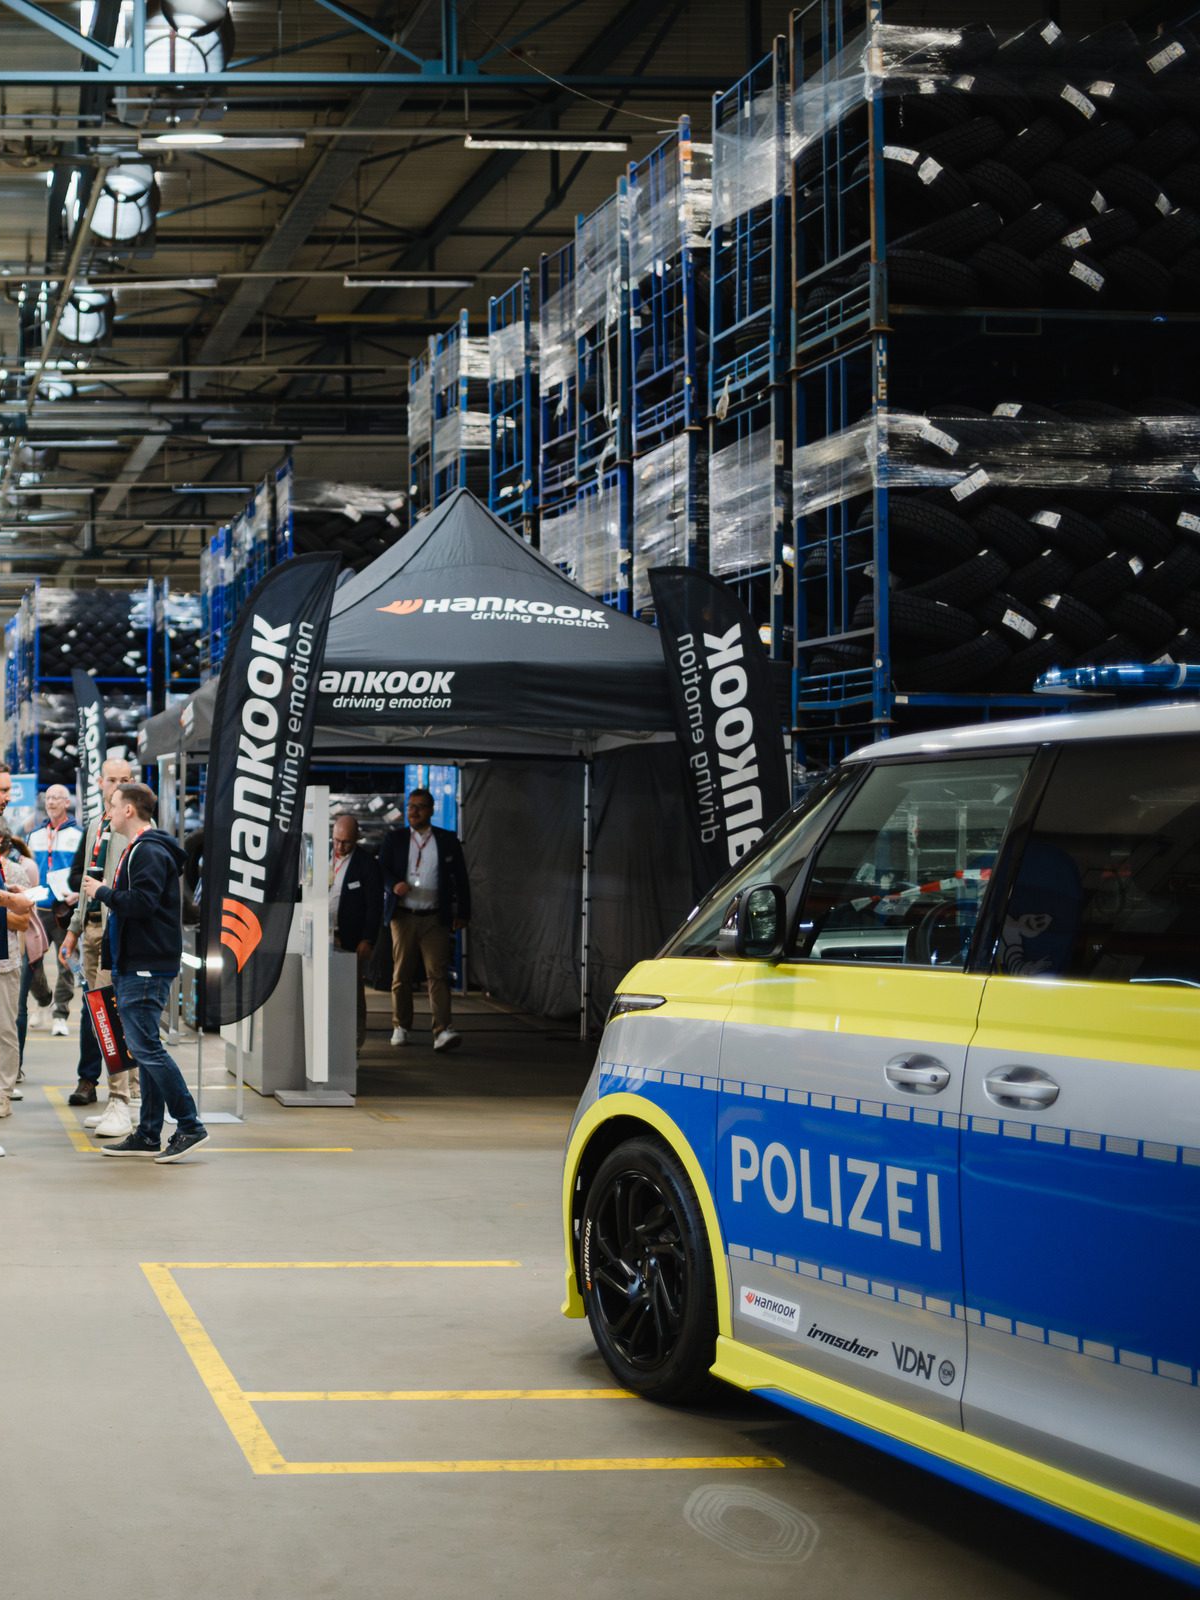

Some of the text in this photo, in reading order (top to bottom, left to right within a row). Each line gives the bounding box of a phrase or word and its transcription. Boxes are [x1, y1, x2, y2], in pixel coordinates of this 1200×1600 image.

[471, 611, 610, 629] driving emotion
[332, 695, 451, 711] driving emotion
[274, 621, 314, 833] driving emotion
[96, 1007, 116, 1056] HEIMSPIEL
[731, 1134, 942, 1252] POLIZEI
[807, 1323, 879, 1359] irmscher
[892, 1342, 936, 1380] VDAT
